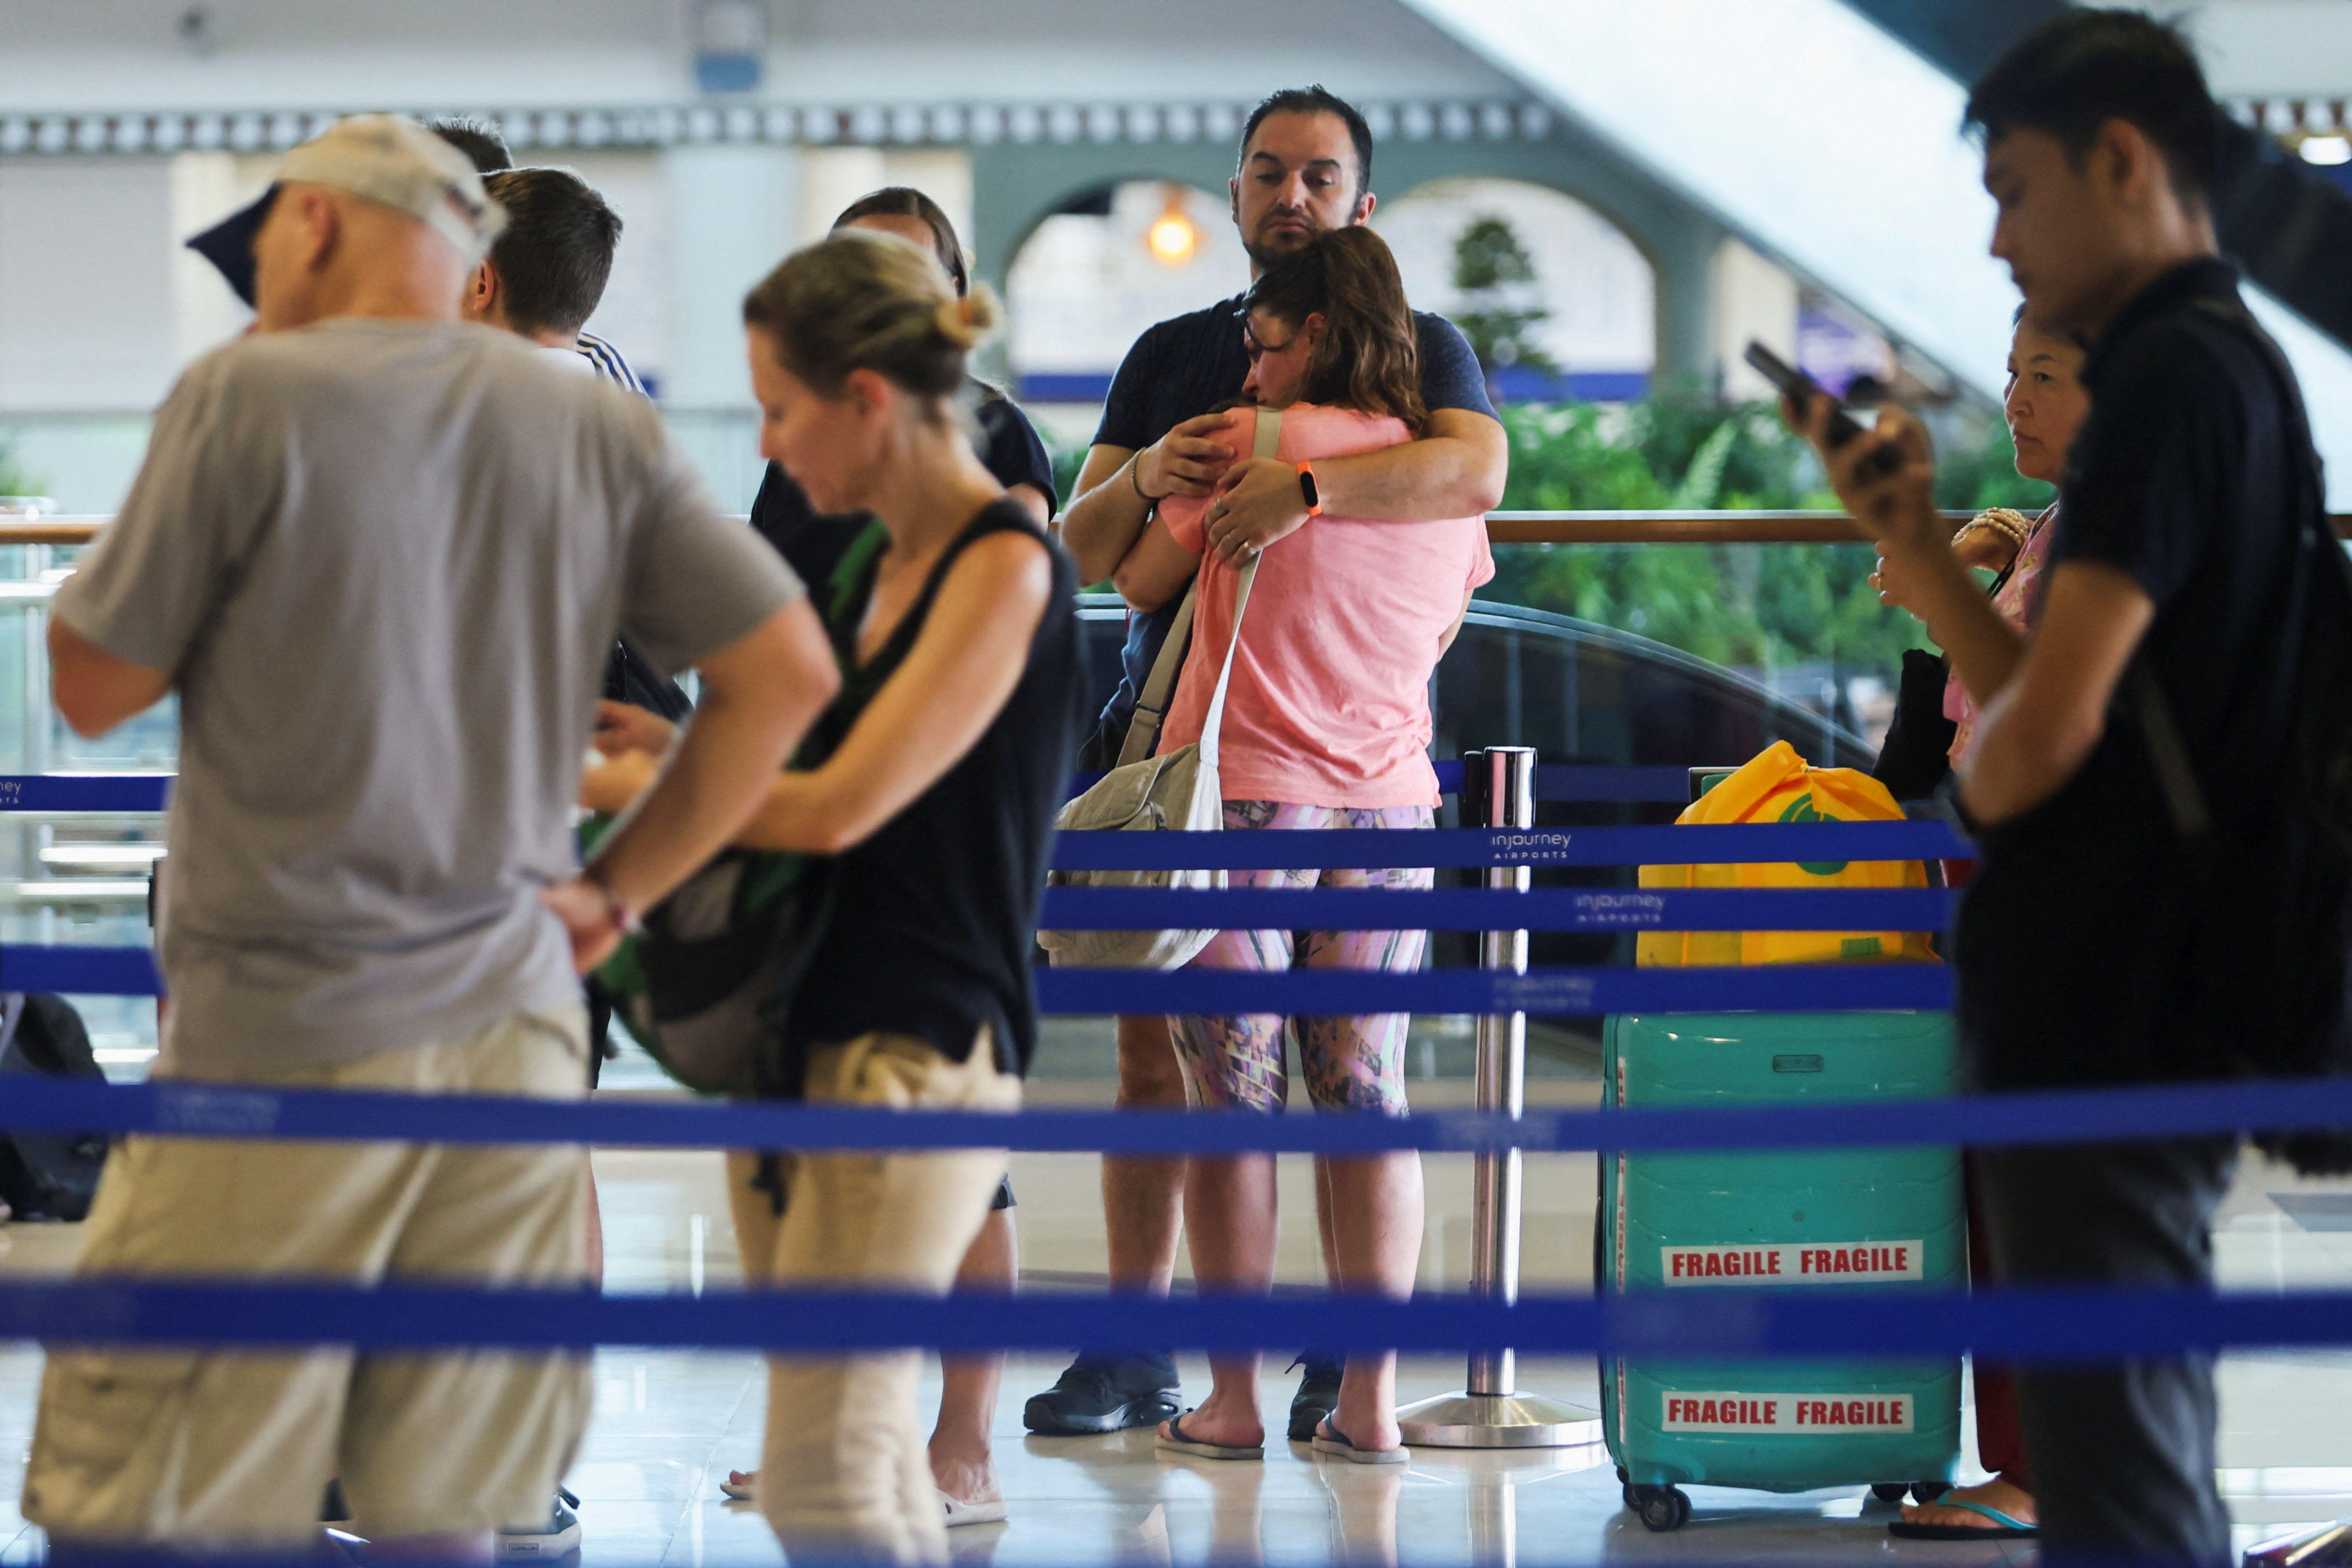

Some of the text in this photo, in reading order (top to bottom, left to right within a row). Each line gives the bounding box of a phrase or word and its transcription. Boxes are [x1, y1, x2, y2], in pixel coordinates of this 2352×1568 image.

[1492, 834, 1571, 850] injourney
[1672, 1247, 1908, 1277] FRAGILE FRAGILE
[1669, 1399, 1903, 1425] FRAGILE FRAGILE
